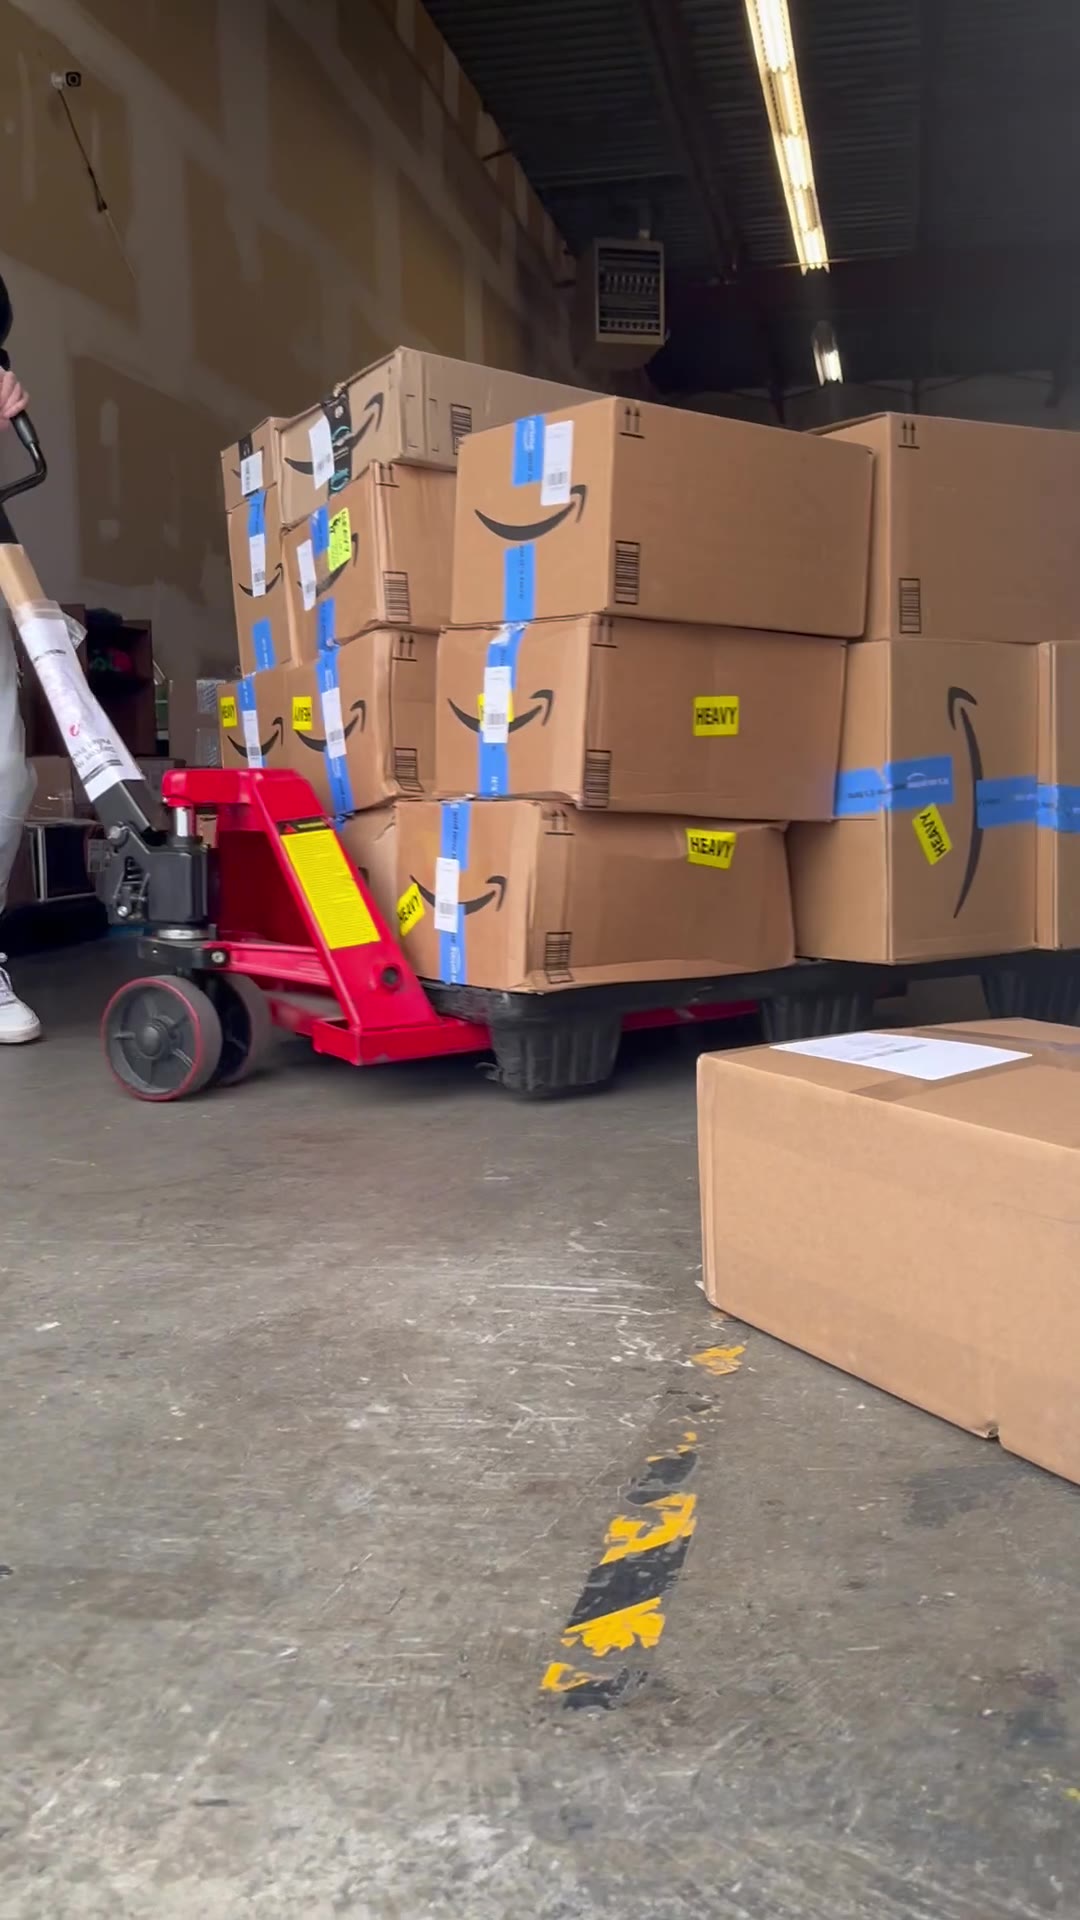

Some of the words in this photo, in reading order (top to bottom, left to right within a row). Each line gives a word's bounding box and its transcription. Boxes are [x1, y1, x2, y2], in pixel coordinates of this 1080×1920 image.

[695, 706, 737, 725] HEAVY
[690, 836, 735, 858] HEAVY
[921, 812, 947, 858] HEAVY
[396, 892, 420, 923] HEAVY
